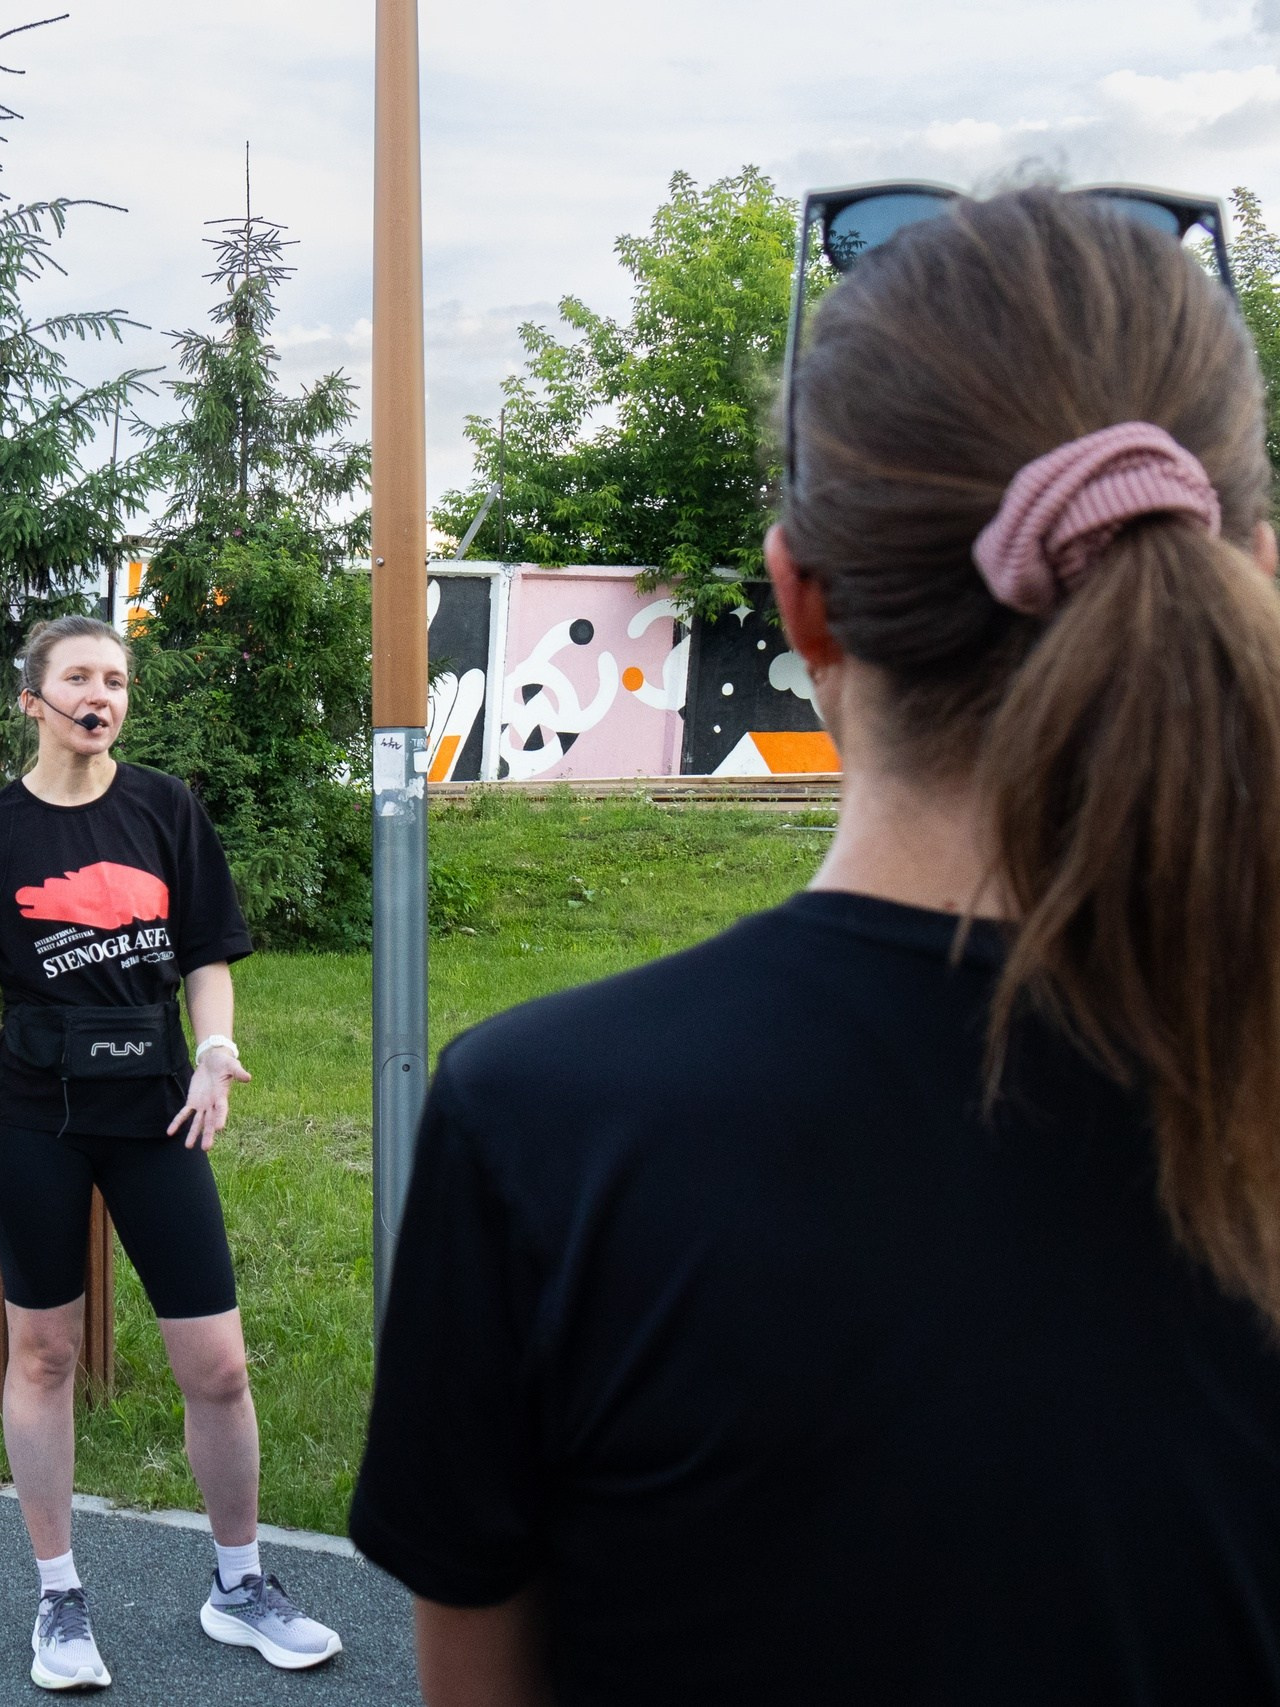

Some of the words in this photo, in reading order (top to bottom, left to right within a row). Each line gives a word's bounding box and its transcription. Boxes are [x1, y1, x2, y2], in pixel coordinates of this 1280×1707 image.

[34, 927, 77, 948] INTERNATIONAL
[36, 942, 56, 955] STREET
[56, 937, 68, 948] ART
[67, 929, 95, 943] FESTIVAL
